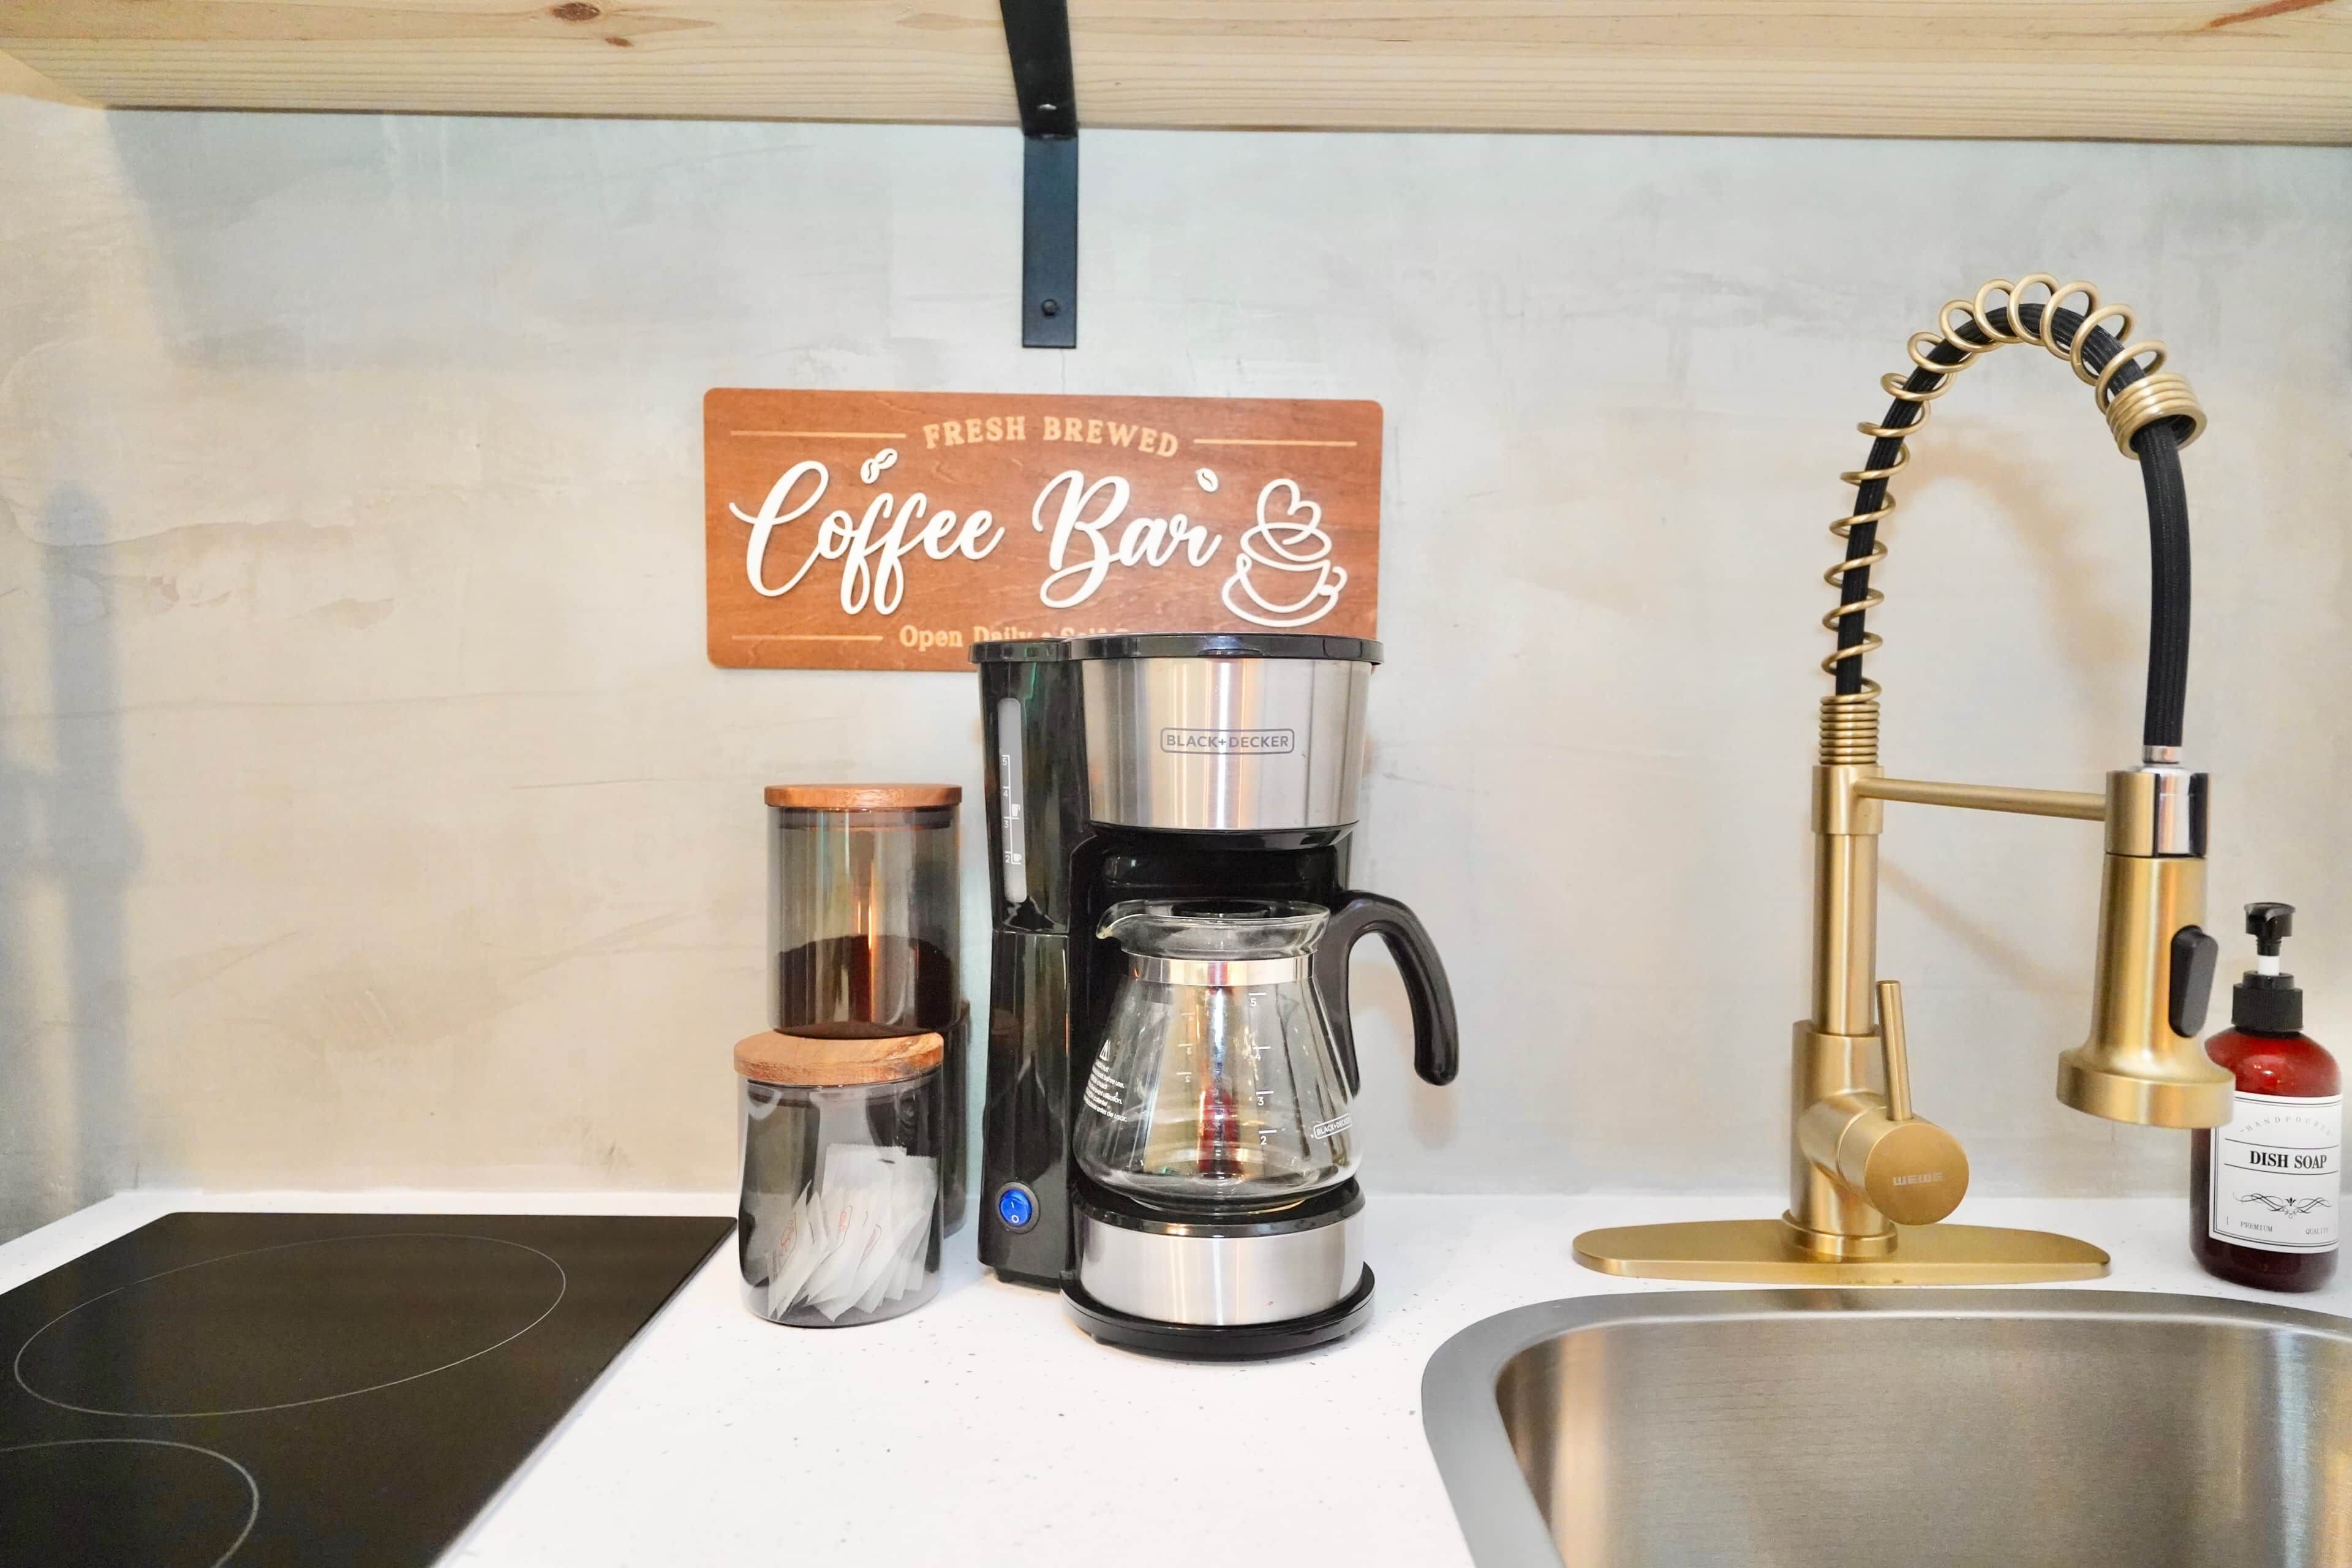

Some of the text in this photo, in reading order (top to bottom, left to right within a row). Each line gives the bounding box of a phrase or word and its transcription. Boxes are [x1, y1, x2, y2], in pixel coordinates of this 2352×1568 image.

[923, 417, 1178, 458] FRESH BREWED
[729, 461, 1223, 615] Coffee Bar
[899, 625, 963, 652] Open
[1166, 734, 1289, 748] BLACK+DECKER
[1250, 998, 1257, 1007] 5
[1257, 1096, 1264, 1106] 3
[1261, 1136, 1267, 1145] 2
[2249, 1150, 2327, 1169] DISH SOAP
[2240, 1221, 2273, 1232] PREMIUM
